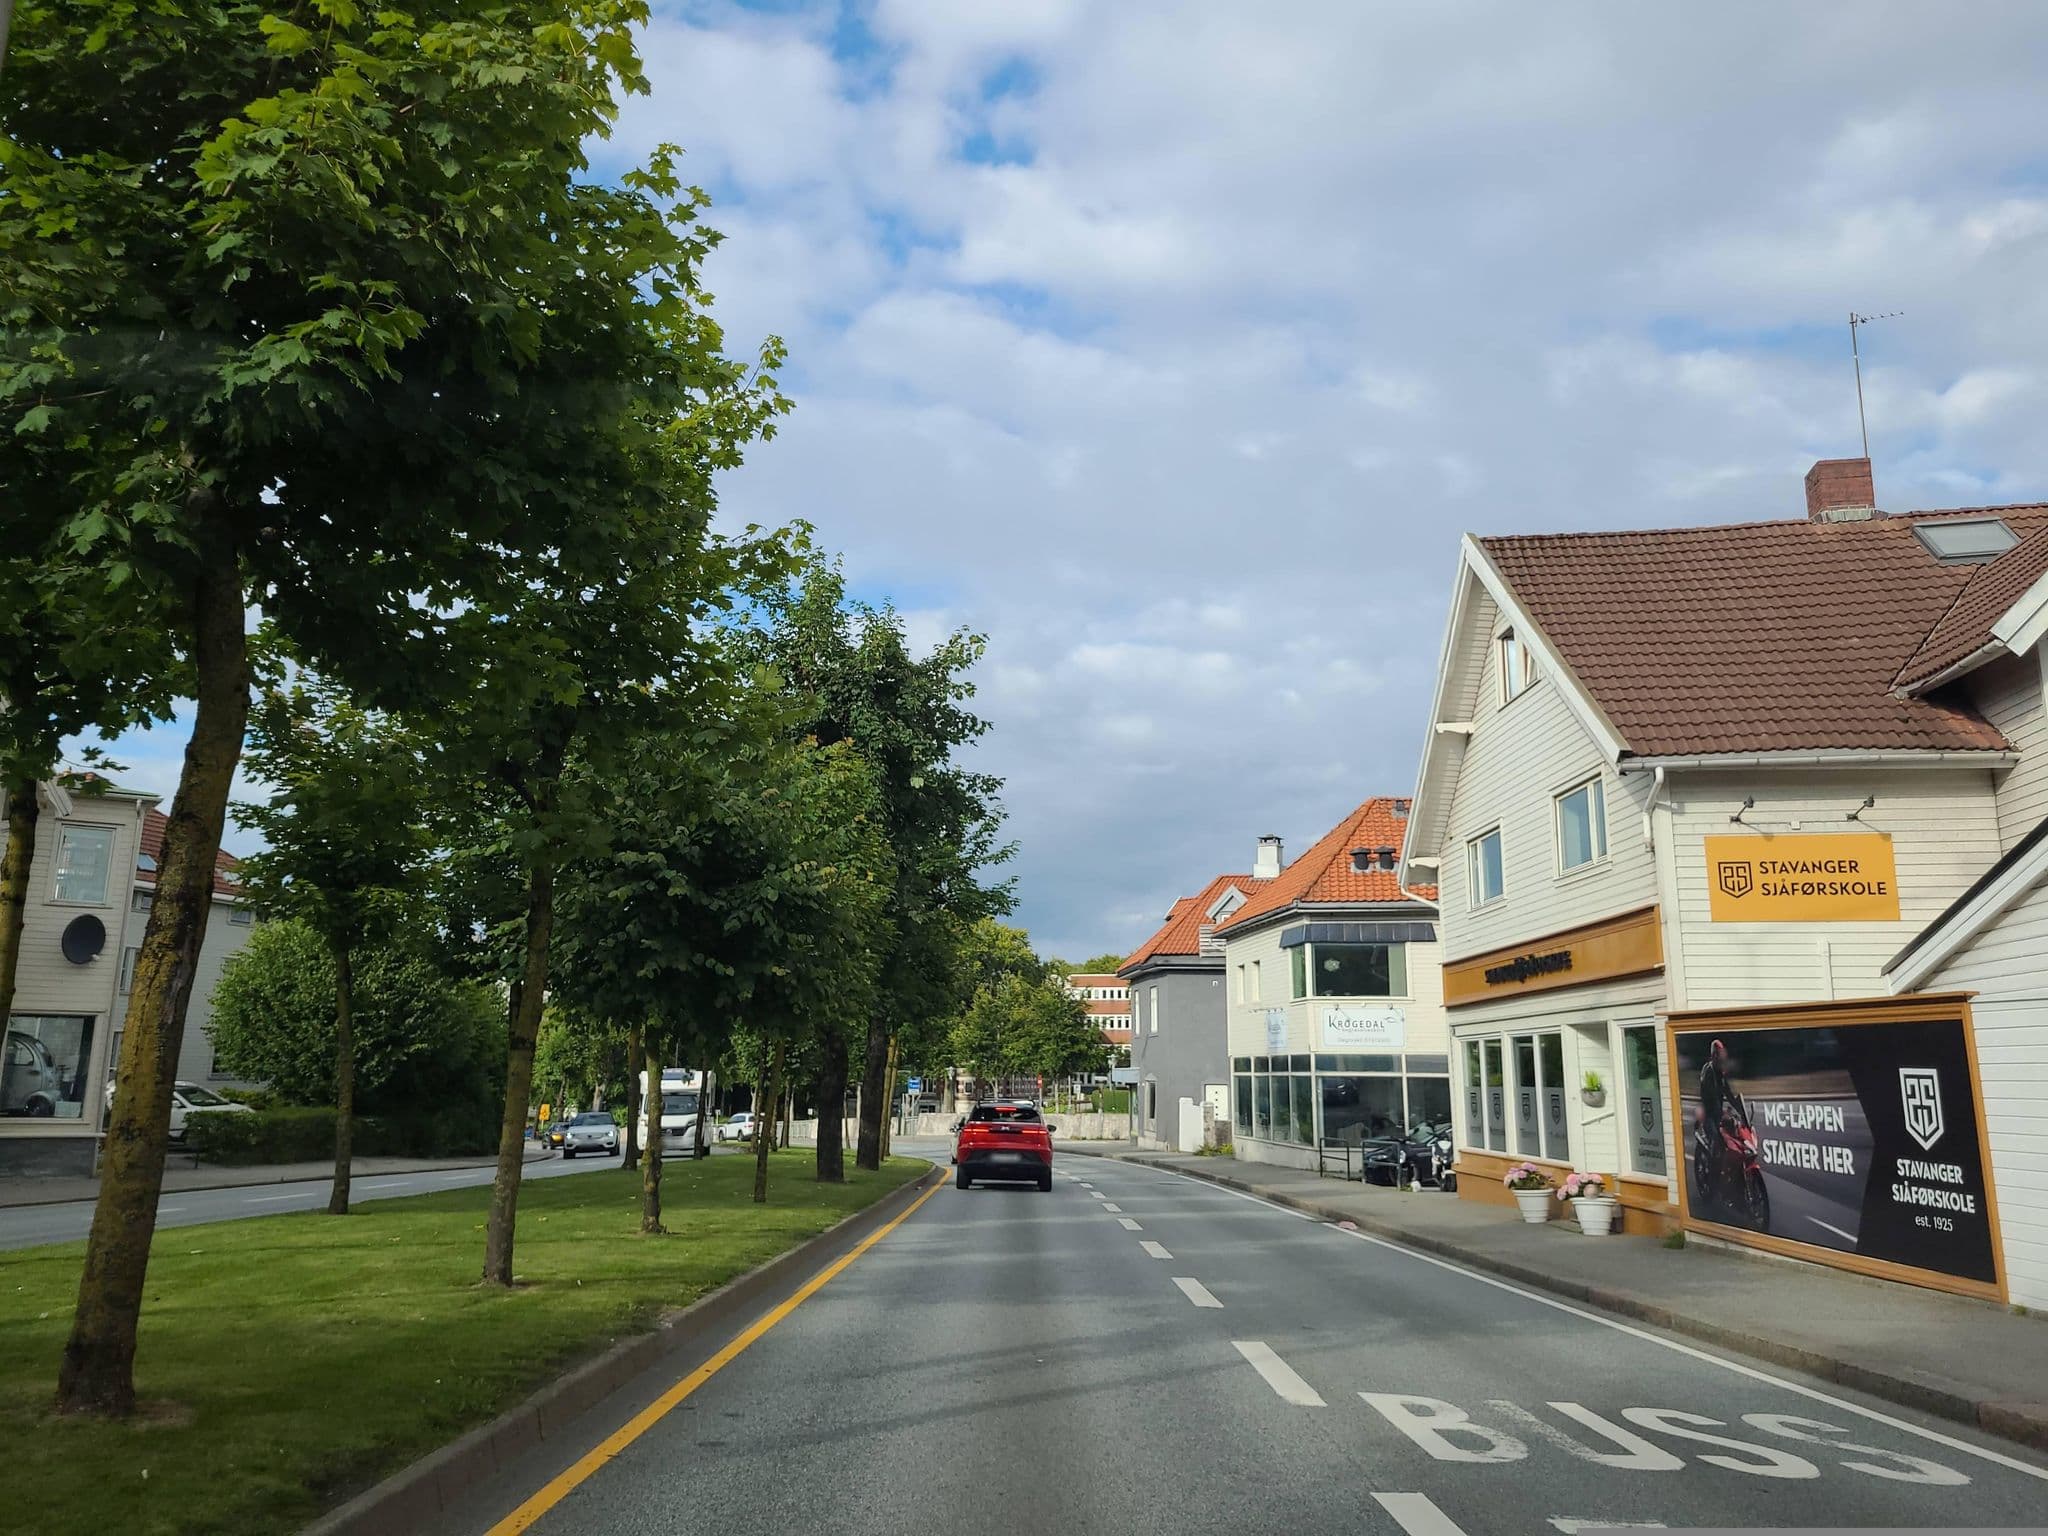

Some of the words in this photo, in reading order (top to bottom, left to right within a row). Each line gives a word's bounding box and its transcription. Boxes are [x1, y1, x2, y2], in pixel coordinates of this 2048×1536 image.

[1759, 860, 1860, 874] STAVANGER
[1761, 878, 1887, 896] SJÅFØRSKOLE
[1763, 1103, 1845, 1133] MC-LAPPEN
[1762, 1139, 1821, 1170] STARTER
[1822, 1145, 1855, 1175] HER
[1896, 1158, 1964, 1185] STAVANGER
[1891, 1180, 1976, 1214] SJÅFØRSKOLE
[1915, 1214, 1932, 1229] est.
[1933, 1215, 1954, 1232] 1925
[1357, 1392, 1973, 1486] BUSS
